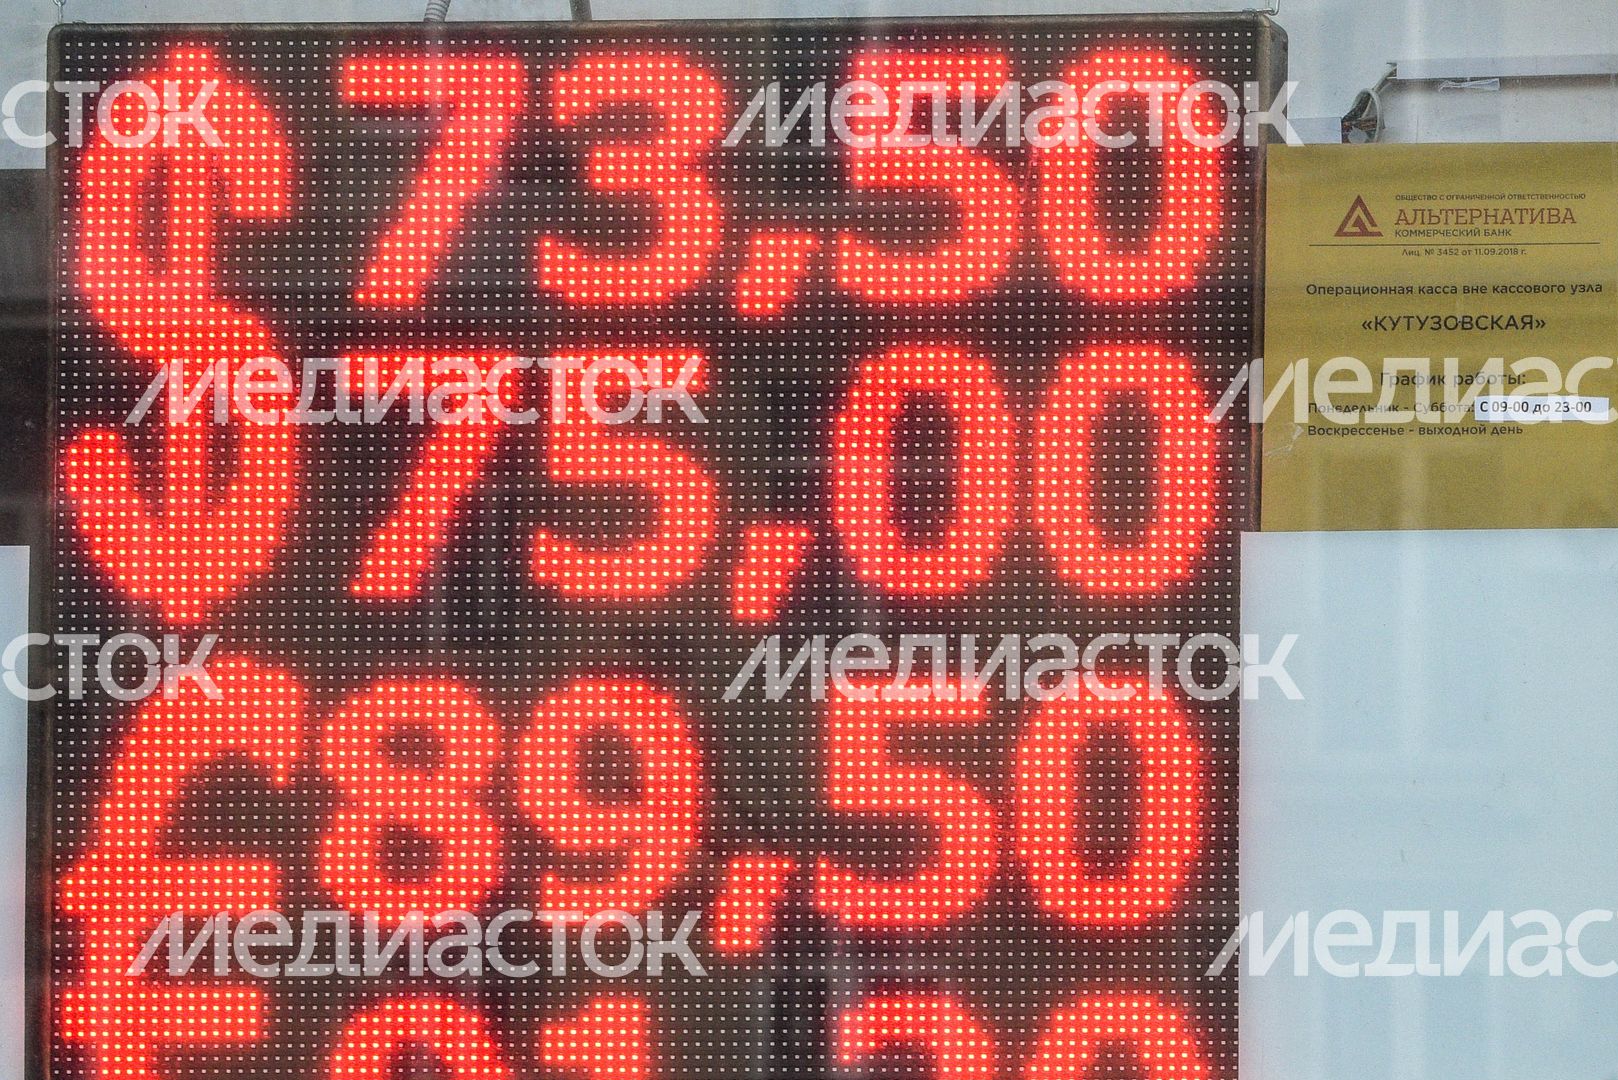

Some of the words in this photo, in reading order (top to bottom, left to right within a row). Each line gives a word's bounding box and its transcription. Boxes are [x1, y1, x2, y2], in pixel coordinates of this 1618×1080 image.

[340, 50, 1221, 316] 73,50
[1395, 194, 1438, 202] ОБЩЕСТВО
[1446, 192, 1505, 200] ОГРАНИЧЕННОЙ
[1507, 192, 1586, 200] ОТВЕТСТВЕННОСТЬЮ
[1394, 208, 1577, 226] АЛЬТЕРНАТИВА
[1395, 227, 1481, 238] КОММЕРЧЕСКИЙ
[1484, 228, 1512, 237] БАНК
[1475, 248, 1519, 256] 11.09.2018
[1306, 284, 1414, 297] Операционная
[1418, 285, 1458, 295] касса
[1463, 285, 1488, 295] вне
[1492, 284, 1566, 294] кассового
[1570, 284, 1603, 296] узла
[1362, 314, 1547, 332] «КУТУЗОВСКАЯ»
[64, 45, 297, 626] $
[1380, 372, 1445, 388] График
[1453, 371, 1526, 386] работы:
[1308, 402, 1400, 414] Понедельник
[1491, 401, 1529, 413] 09-00
[1532, 403, 1551, 415] до
[1554, 401, 1592, 413] 23-00
[1308, 425, 1405, 437] Воскрессенье
[1419, 424, 1487, 436] выходной
[1491, 426, 1523, 437] день
[346, 345, 1216, 622] 75,00
[318, 675, 1202, 955] 89,50
